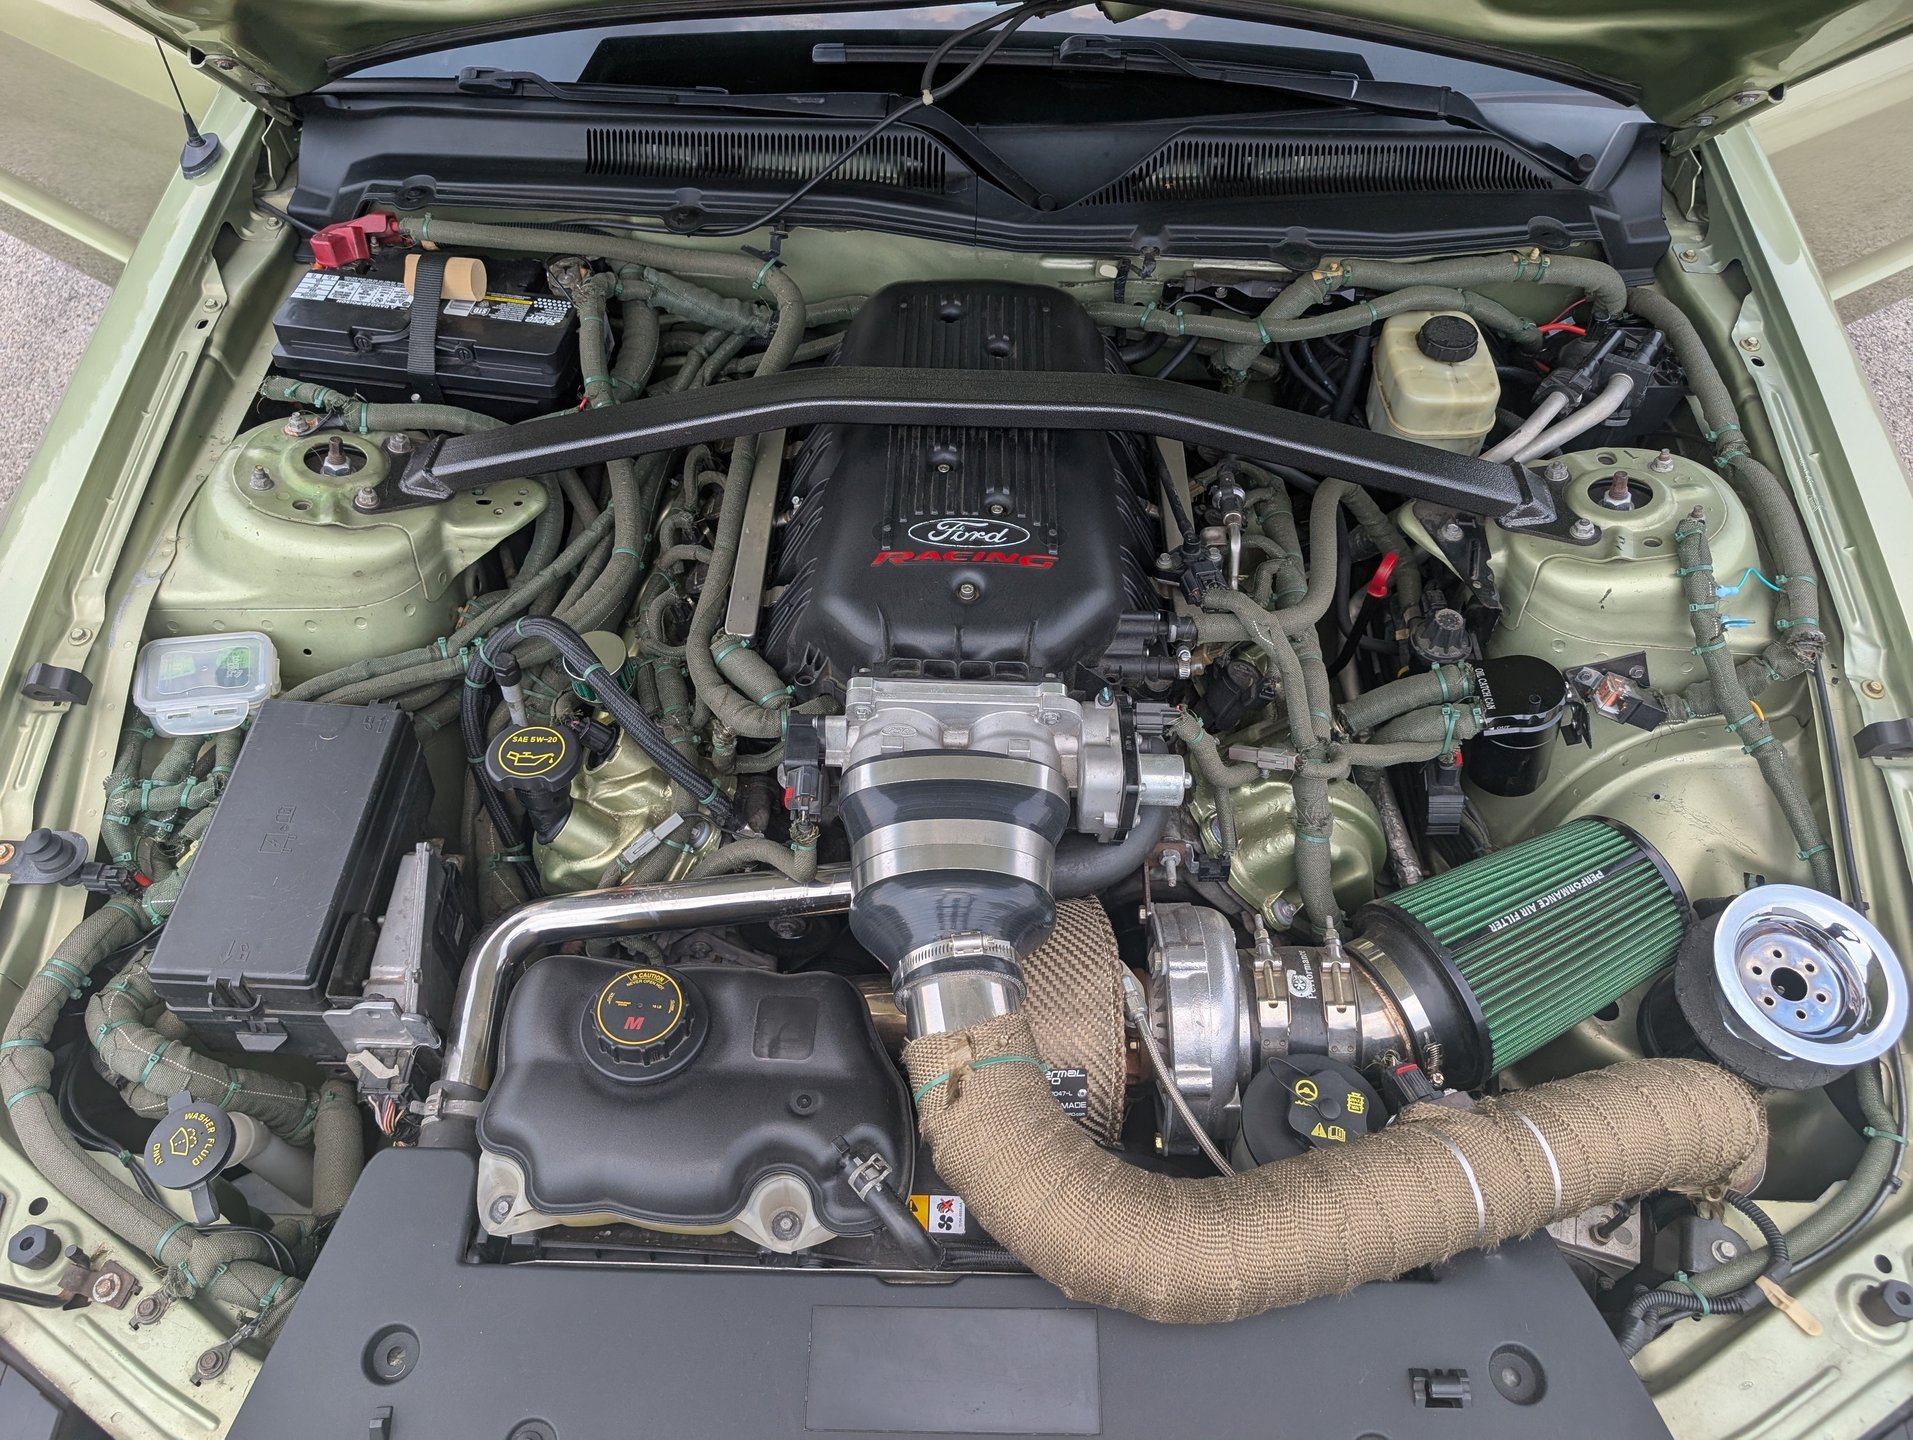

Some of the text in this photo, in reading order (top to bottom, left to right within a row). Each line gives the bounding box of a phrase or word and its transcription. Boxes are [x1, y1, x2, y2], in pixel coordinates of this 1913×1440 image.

[928, 520, 1007, 543] Ford
[871, 550, 1060, 568] RACING
[1475, 668, 1496, 710] OIL CATCH CAN
[1488, 870, 1605, 932] PERFORMANCE AIR FILTER
[638, 972, 665, 983] CAUTION
[624, 1016, 645, 1030] M
[153, 1111, 217, 1167] WASHER FLUID ONLY
